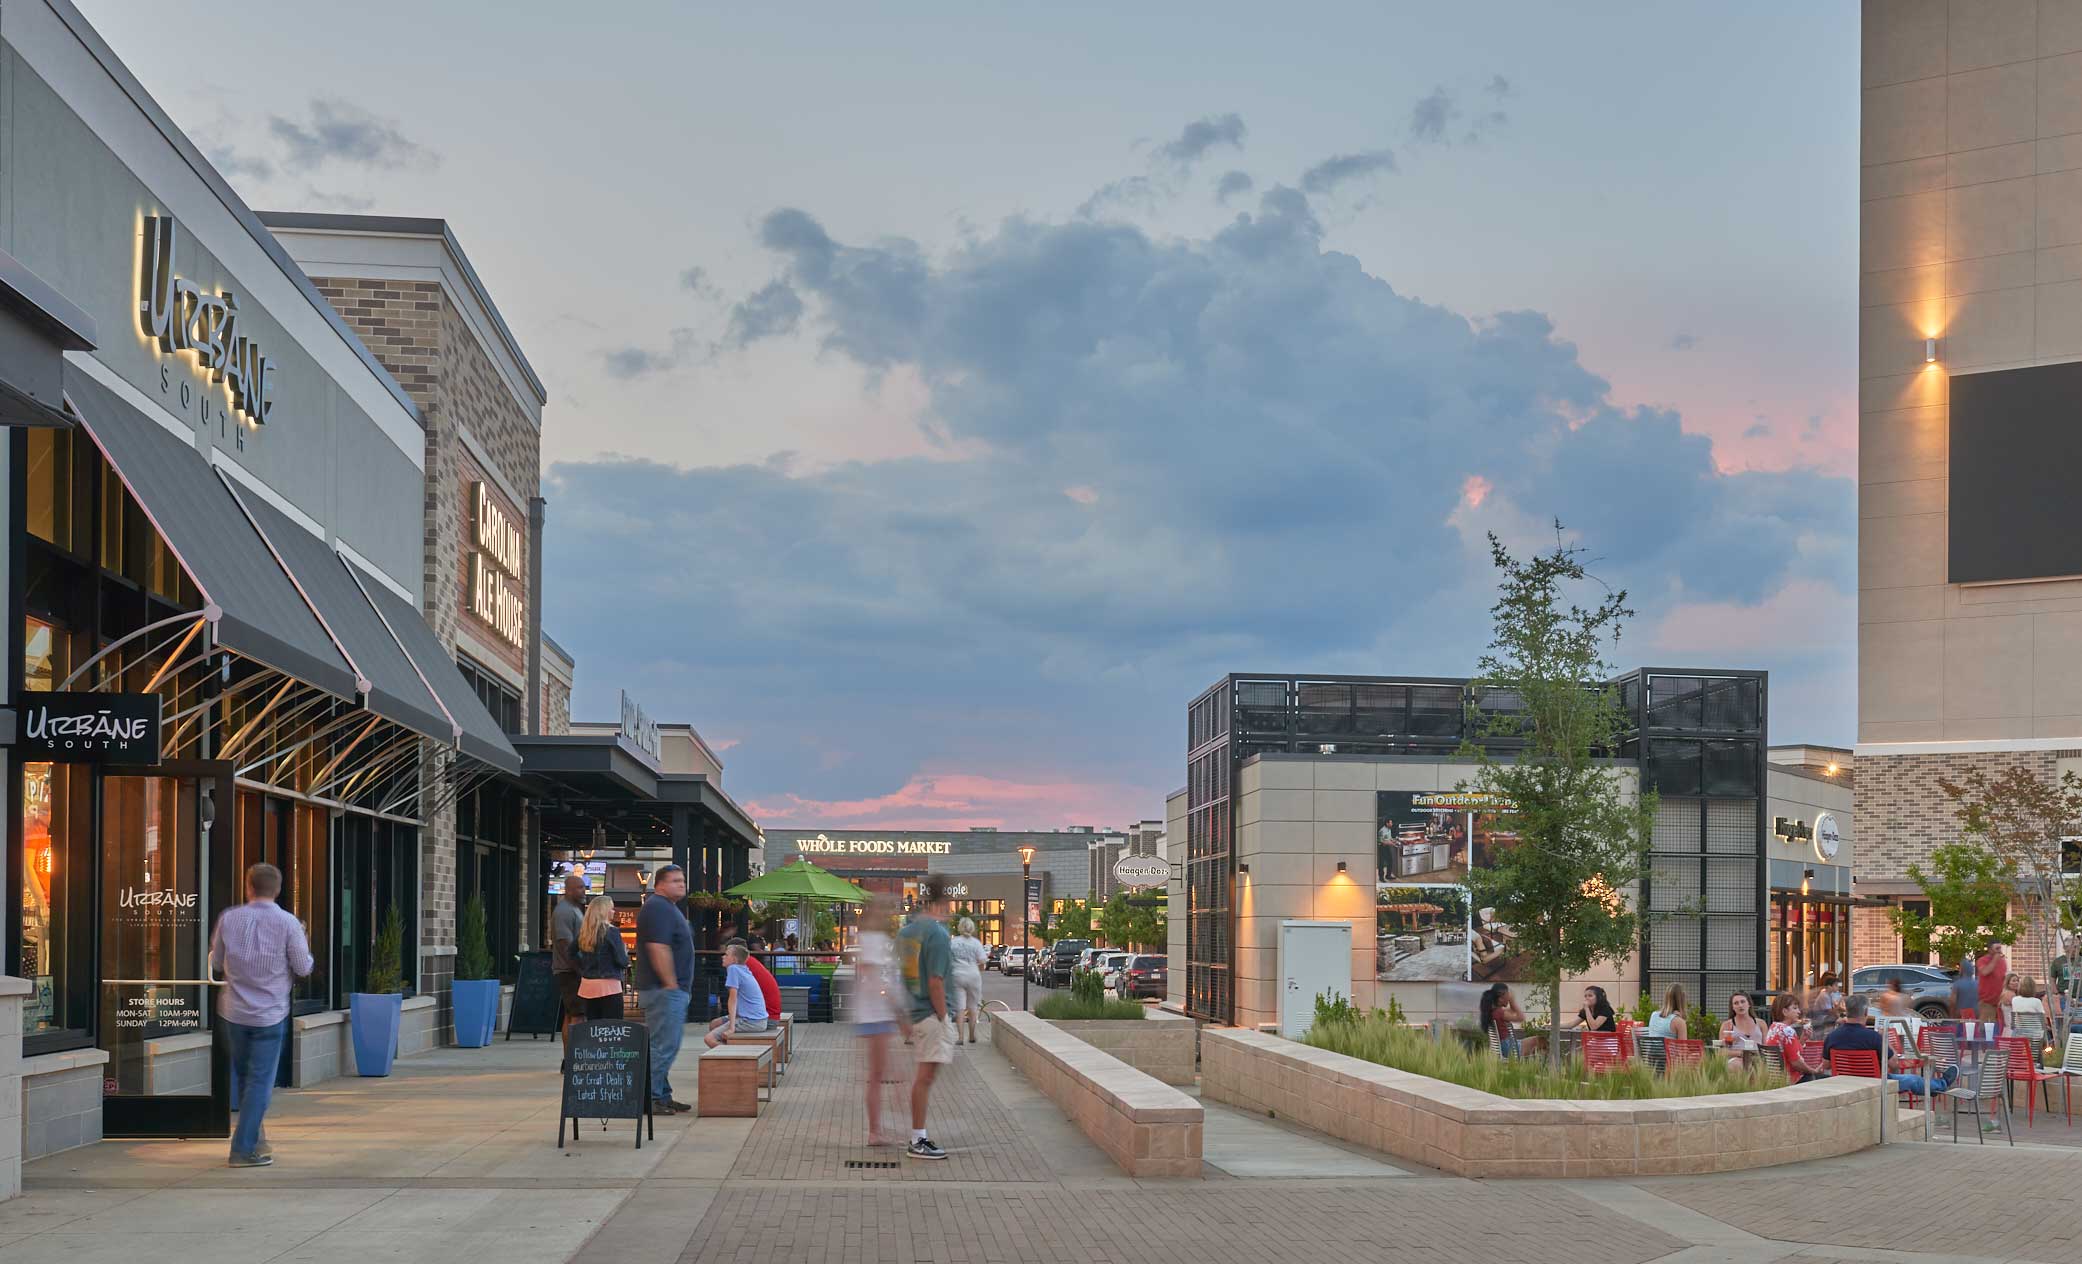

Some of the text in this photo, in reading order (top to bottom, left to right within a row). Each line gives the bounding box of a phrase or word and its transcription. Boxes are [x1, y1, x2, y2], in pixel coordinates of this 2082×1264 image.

[160, 362, 244, 453] SOUTH
[474, 480, 521, 581] CAROLINA
[473, 552, 523, 649] ALE HOUSE
[47, 740, 128, 750] SOUTH
[1412, 794, 1434, 806] Fun
[797, 834, 952, 854] WHOLE FOODS MARKET
[128, 998, 185, 1006] STORE HOURS
[115, 1009, 200, 1017] MON-SAT 10AM-9PM
[596, 1047, 608, 1060] Our
[615, 1060, 626, 1071] for
[572, 1074, 584, 1086] Our
[586, 1073, 603, 1086] Great
[576, 1088, 597, 1101] Latest
